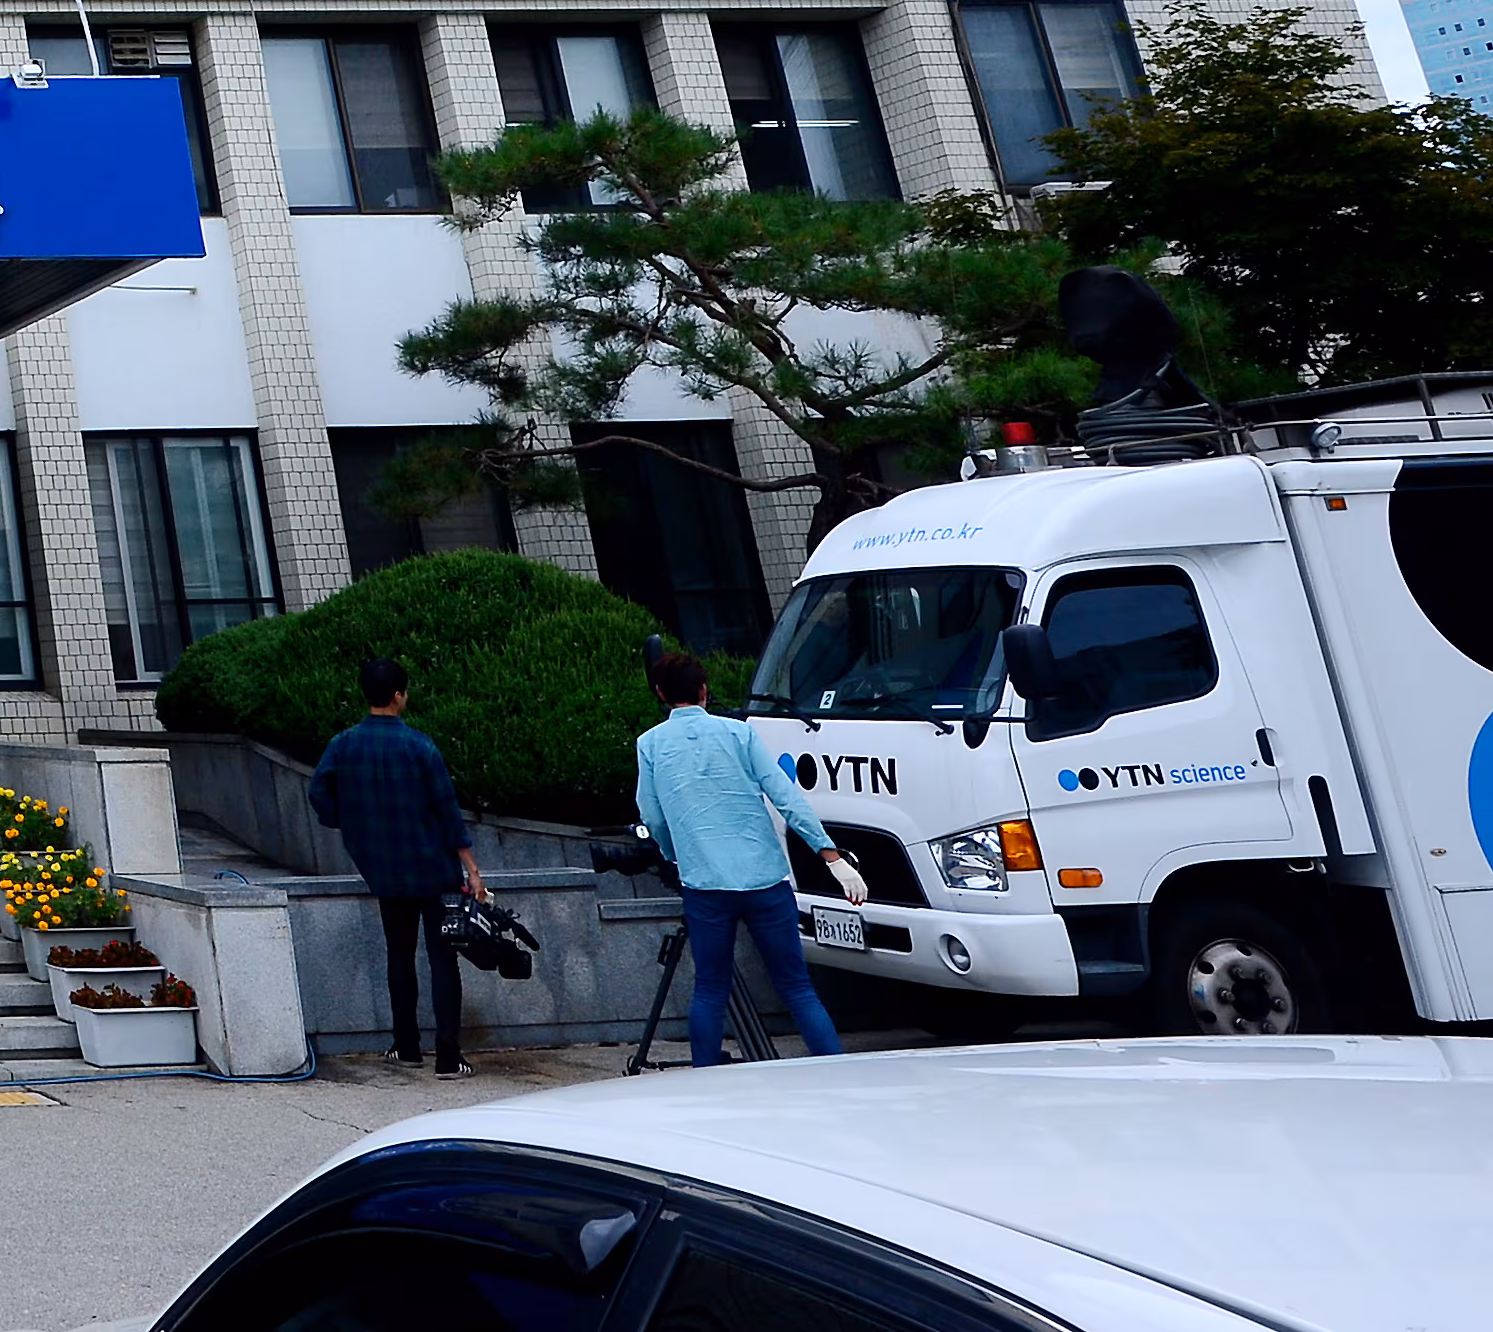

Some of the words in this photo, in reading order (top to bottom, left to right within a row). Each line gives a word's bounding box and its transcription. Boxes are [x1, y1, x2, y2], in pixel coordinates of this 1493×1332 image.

[852, 523, 983, 551] www.ytn.co.kr
[823, 693, 832, 706] 2
[821, 754, 899, 796] YTN
[1100, 763, 1165, 788] YTN
[1169, 764, 1246, 784] science
